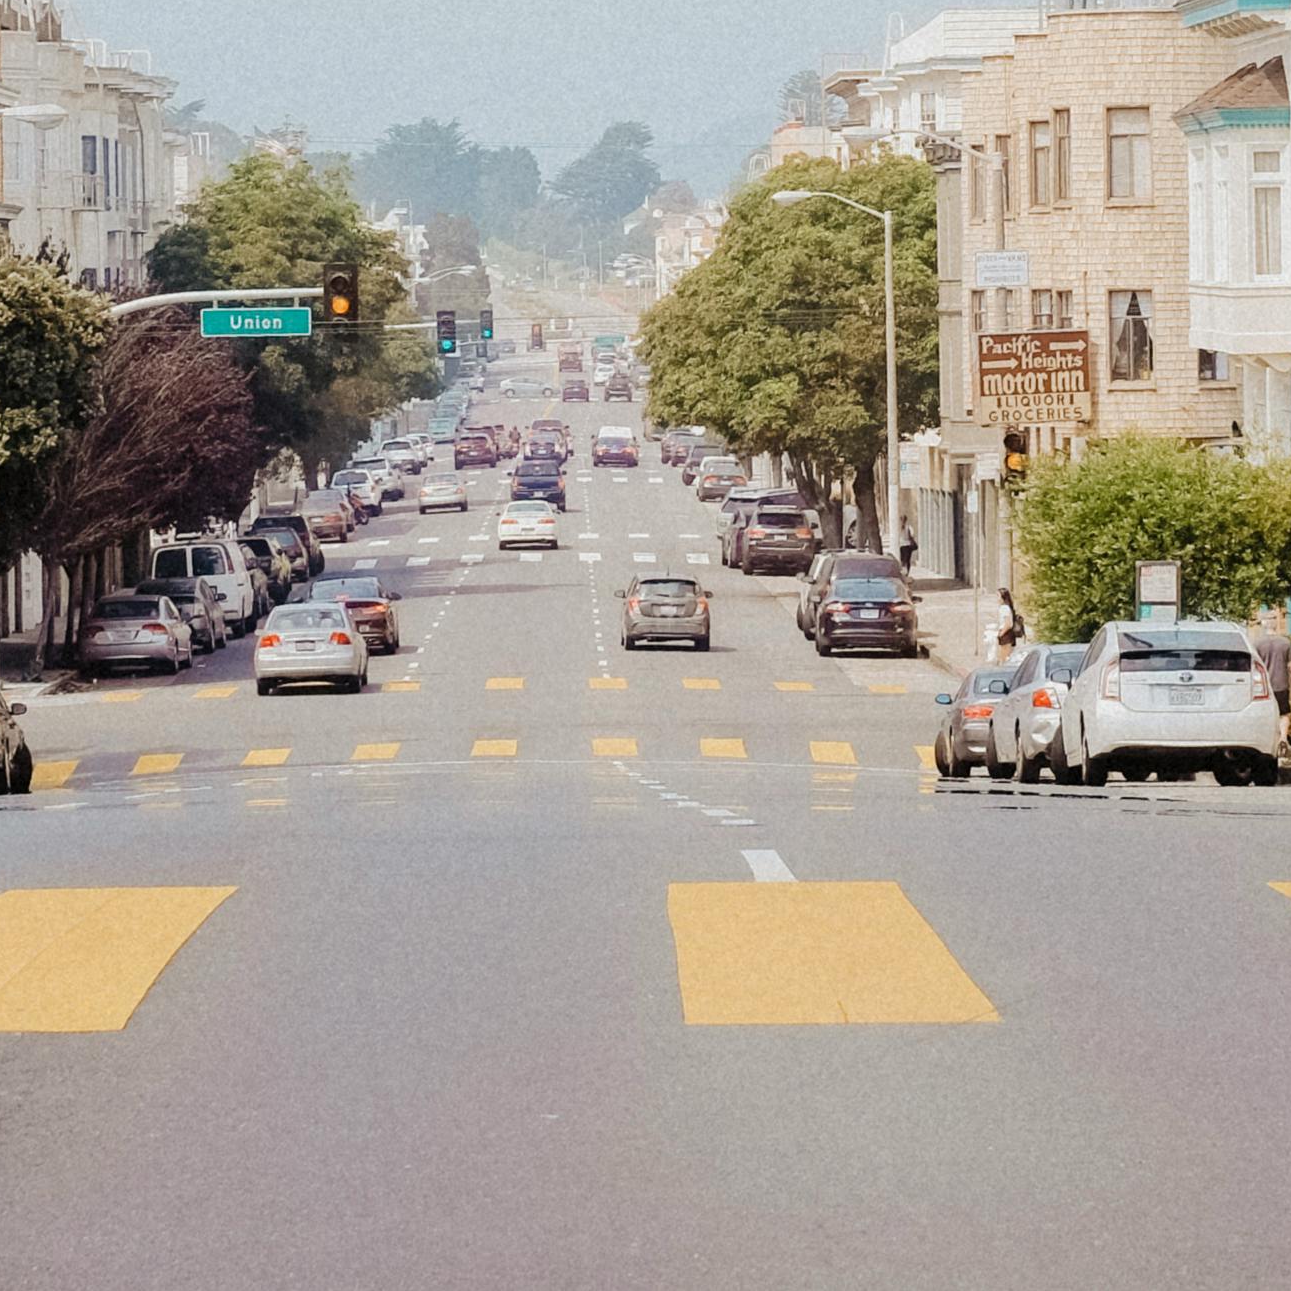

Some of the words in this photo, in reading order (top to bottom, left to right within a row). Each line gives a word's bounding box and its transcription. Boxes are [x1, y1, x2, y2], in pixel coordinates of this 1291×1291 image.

[229, 314, 282, 331] Union
[981, 335, 1041, 356] Pacific
[1021, 350, 1083, 372] Heights
[1005, 394, 1065, 408] LIQUOR
[989, 407, 1083, 422] GROCERIES
